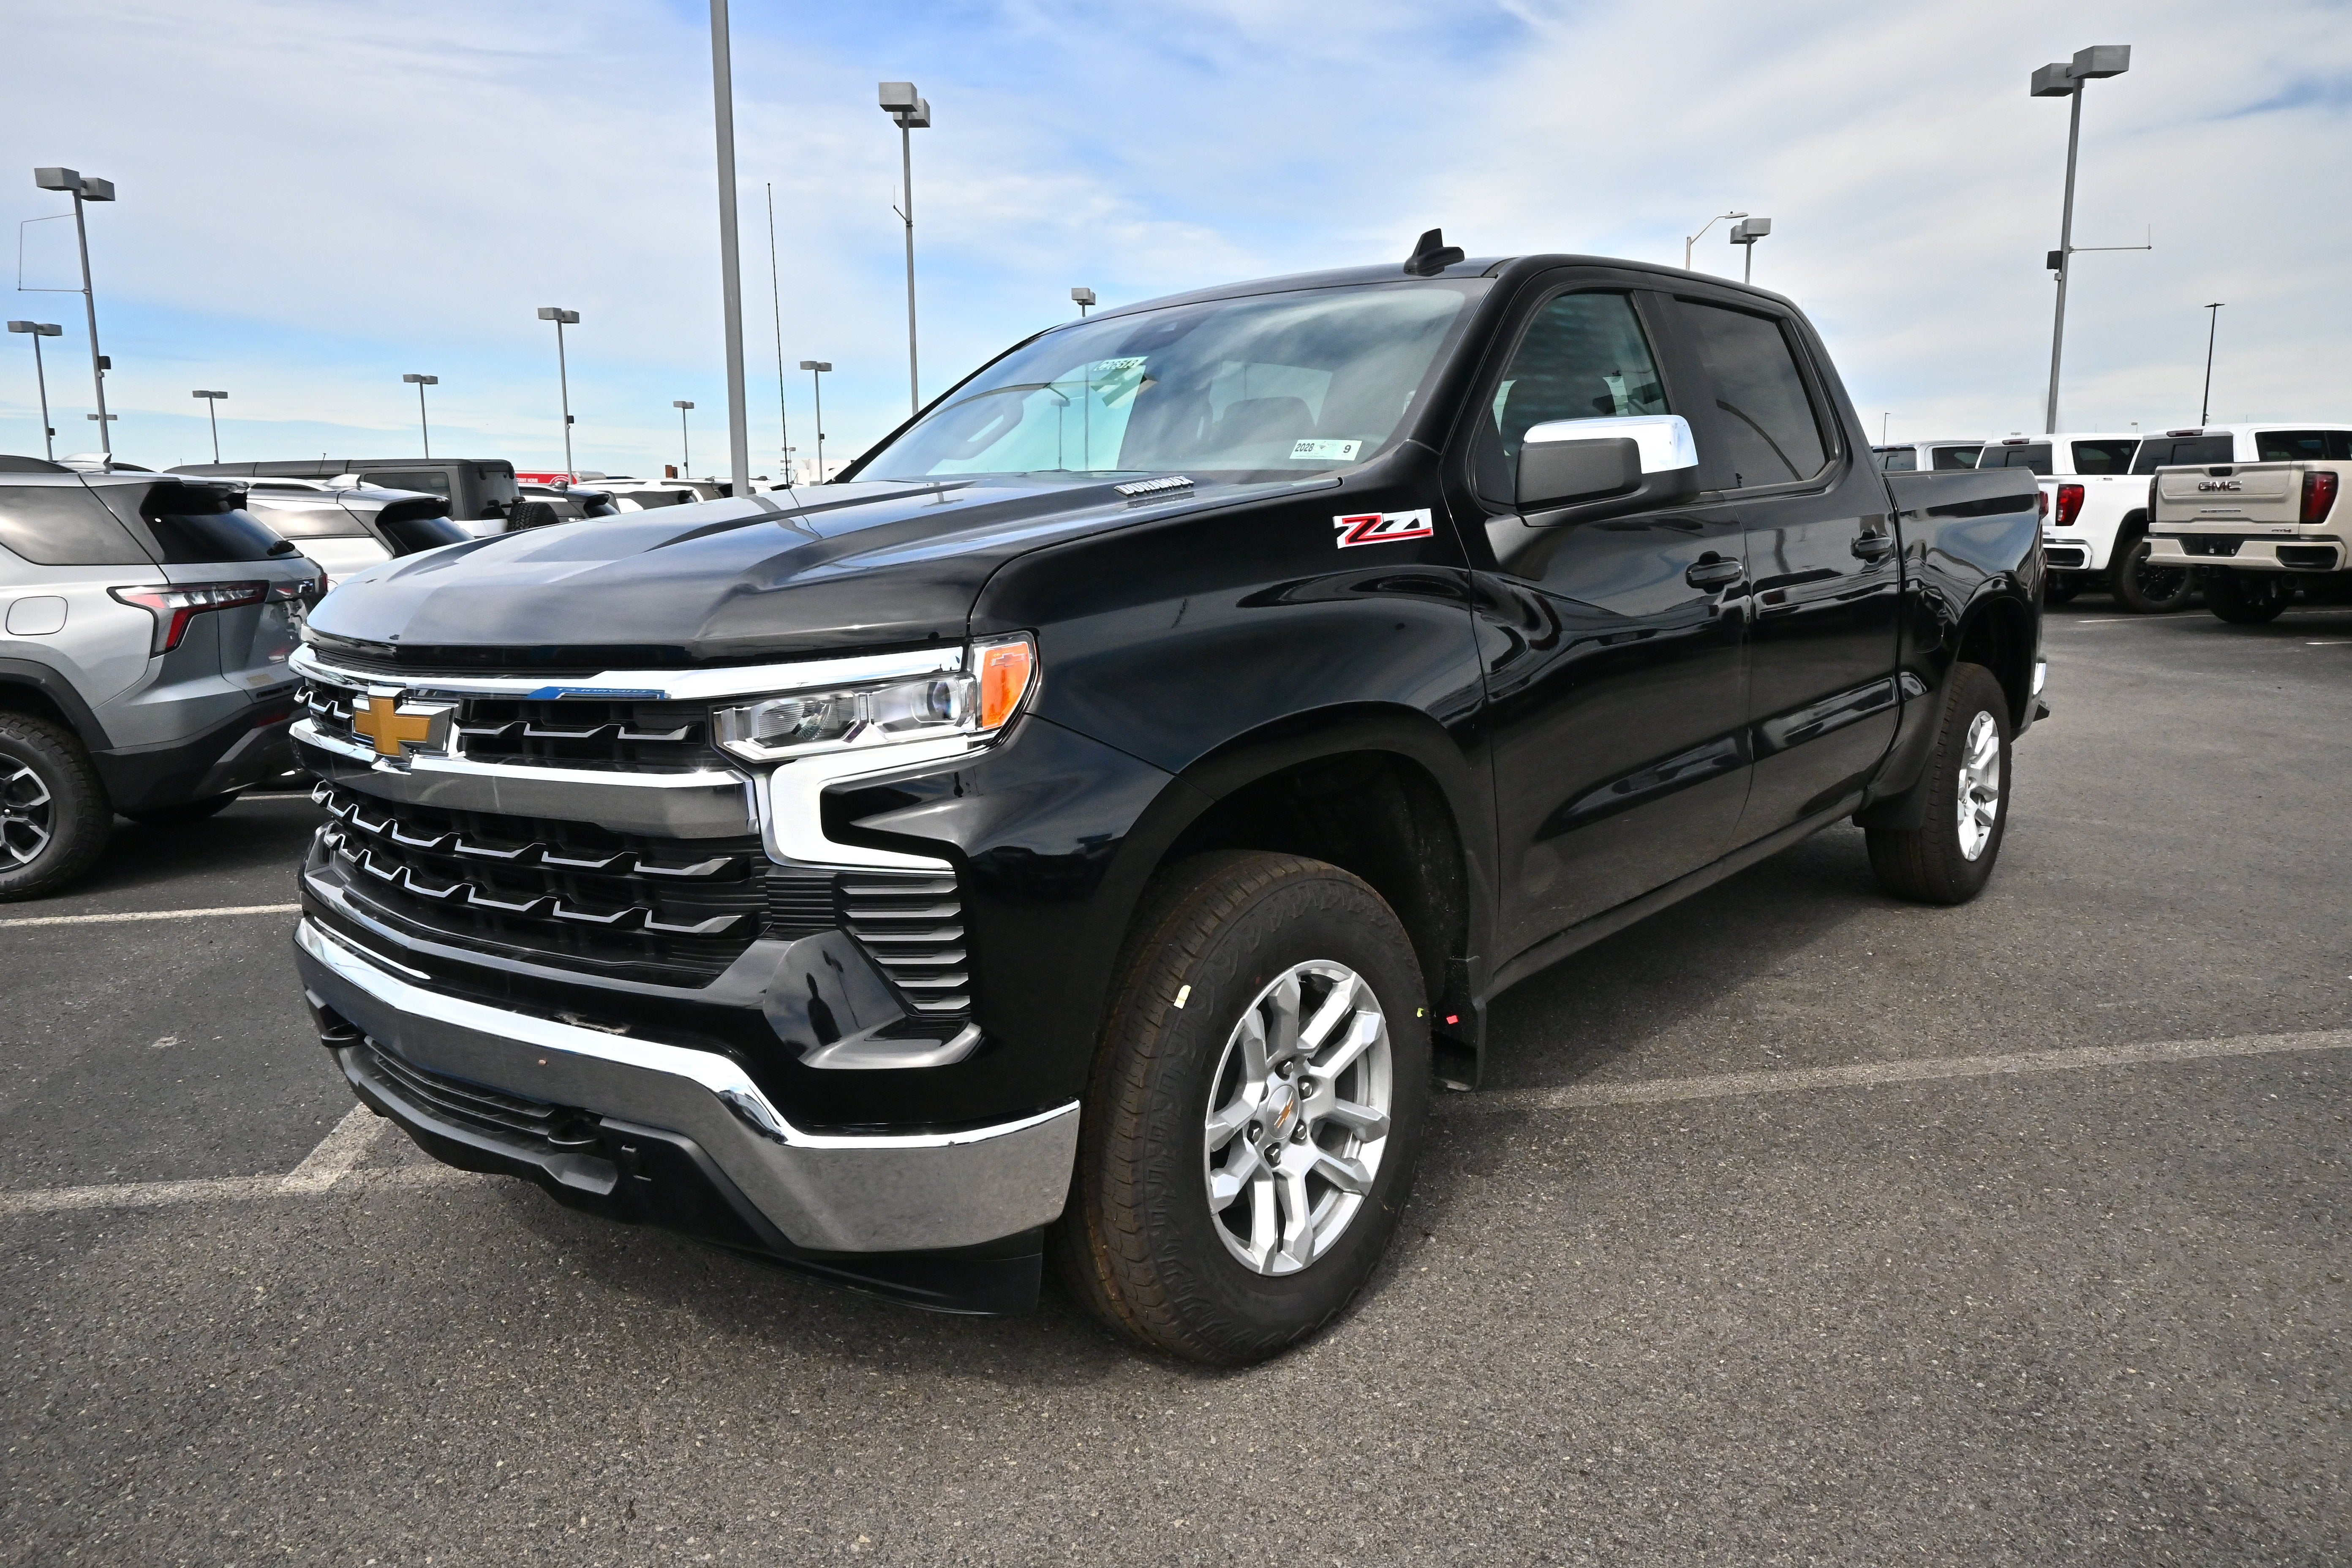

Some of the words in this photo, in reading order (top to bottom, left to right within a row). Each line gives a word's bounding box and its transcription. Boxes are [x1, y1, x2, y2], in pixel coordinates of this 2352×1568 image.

[1295, 443, 1315, 452] 2028
[1343, 445, 1351, 453] 9
[1113, 475, 1195, 495] DURAMAX
[2198, 481, 2242, 491] GMC
[1333, 508, 1434, 549] Z71
